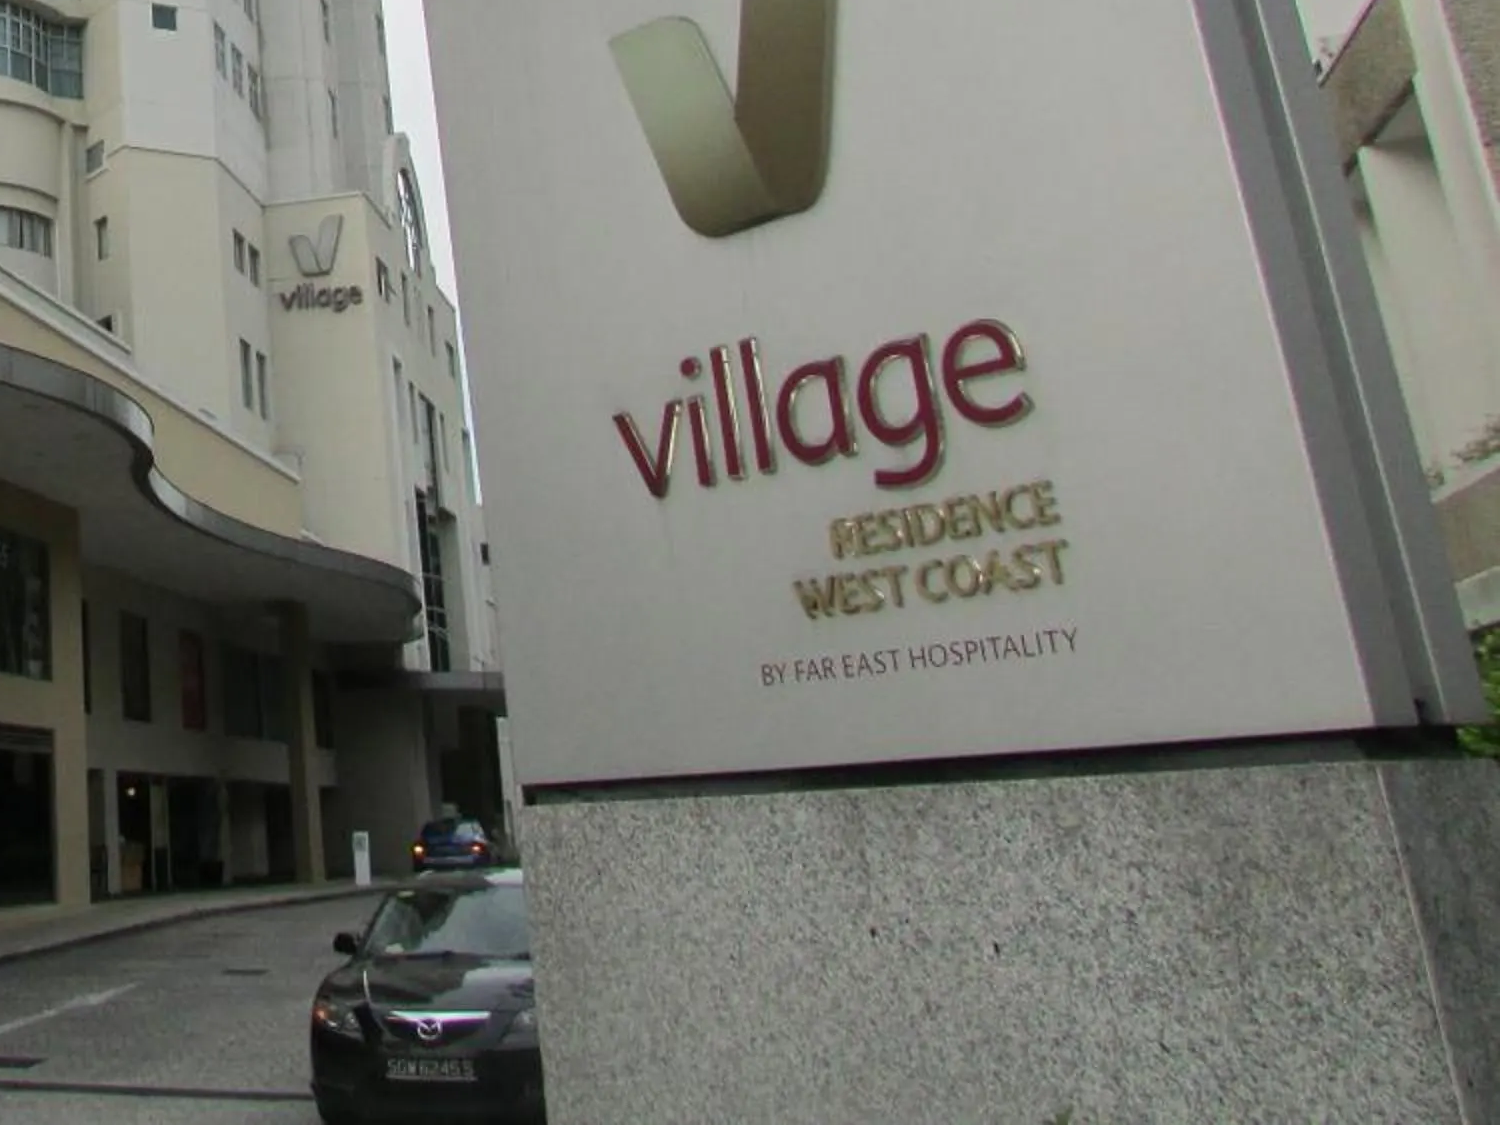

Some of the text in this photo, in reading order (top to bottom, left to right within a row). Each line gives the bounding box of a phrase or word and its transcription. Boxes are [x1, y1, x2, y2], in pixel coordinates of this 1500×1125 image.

[279, 282, 364, 313] village
[612, 318, 1034, 500] village
[828, 479, 1062, 560] RESIDENCE
[792, 539, 1069, 621] WEST COAST
[761, 627, 1078, 687] BY FAR EAST HOSPITALITY
